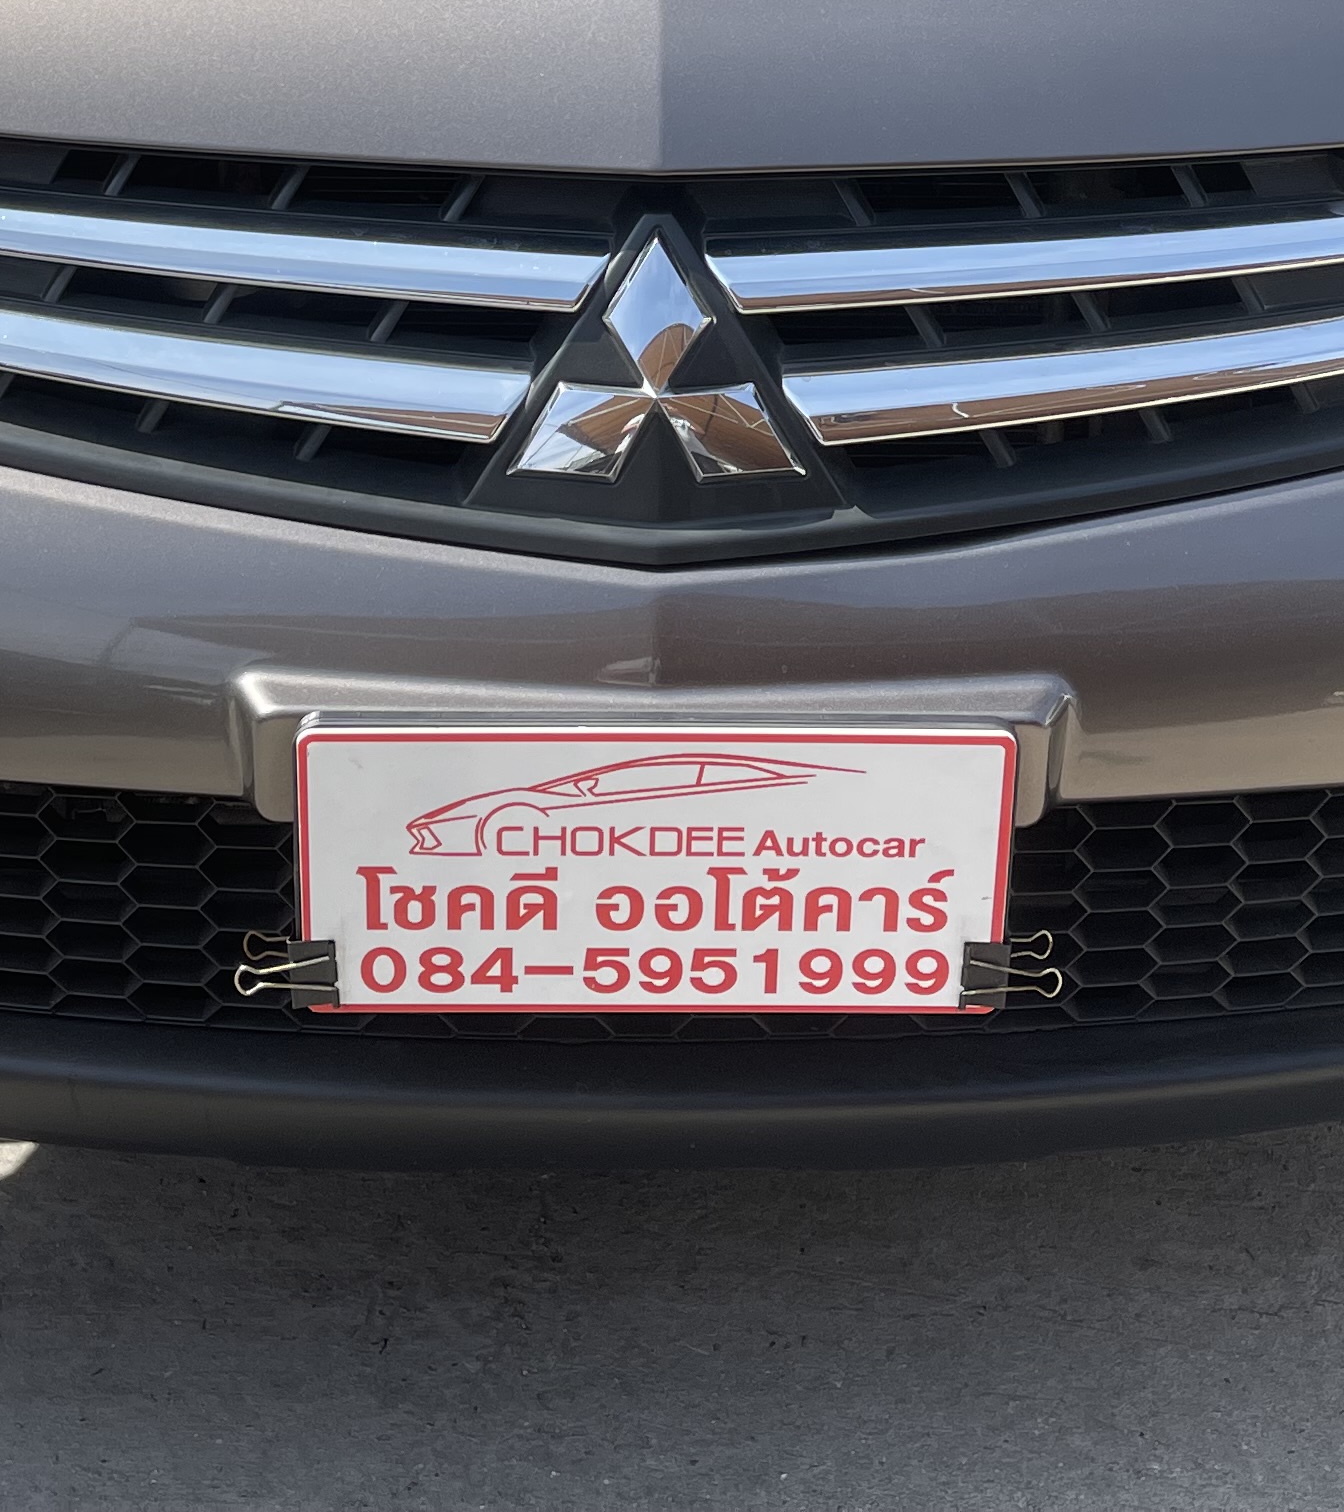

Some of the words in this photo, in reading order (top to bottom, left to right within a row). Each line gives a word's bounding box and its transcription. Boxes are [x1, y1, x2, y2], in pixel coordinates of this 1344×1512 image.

[495, 825, 745, 858] CHOKDEE
[752, 828, 926, 859] Autocar
[355, 865, 559, 932] โชคดี
[595, 866, 955, 933] ออโต้คาร์
[360, 946, 950, 996] 084-5951999
